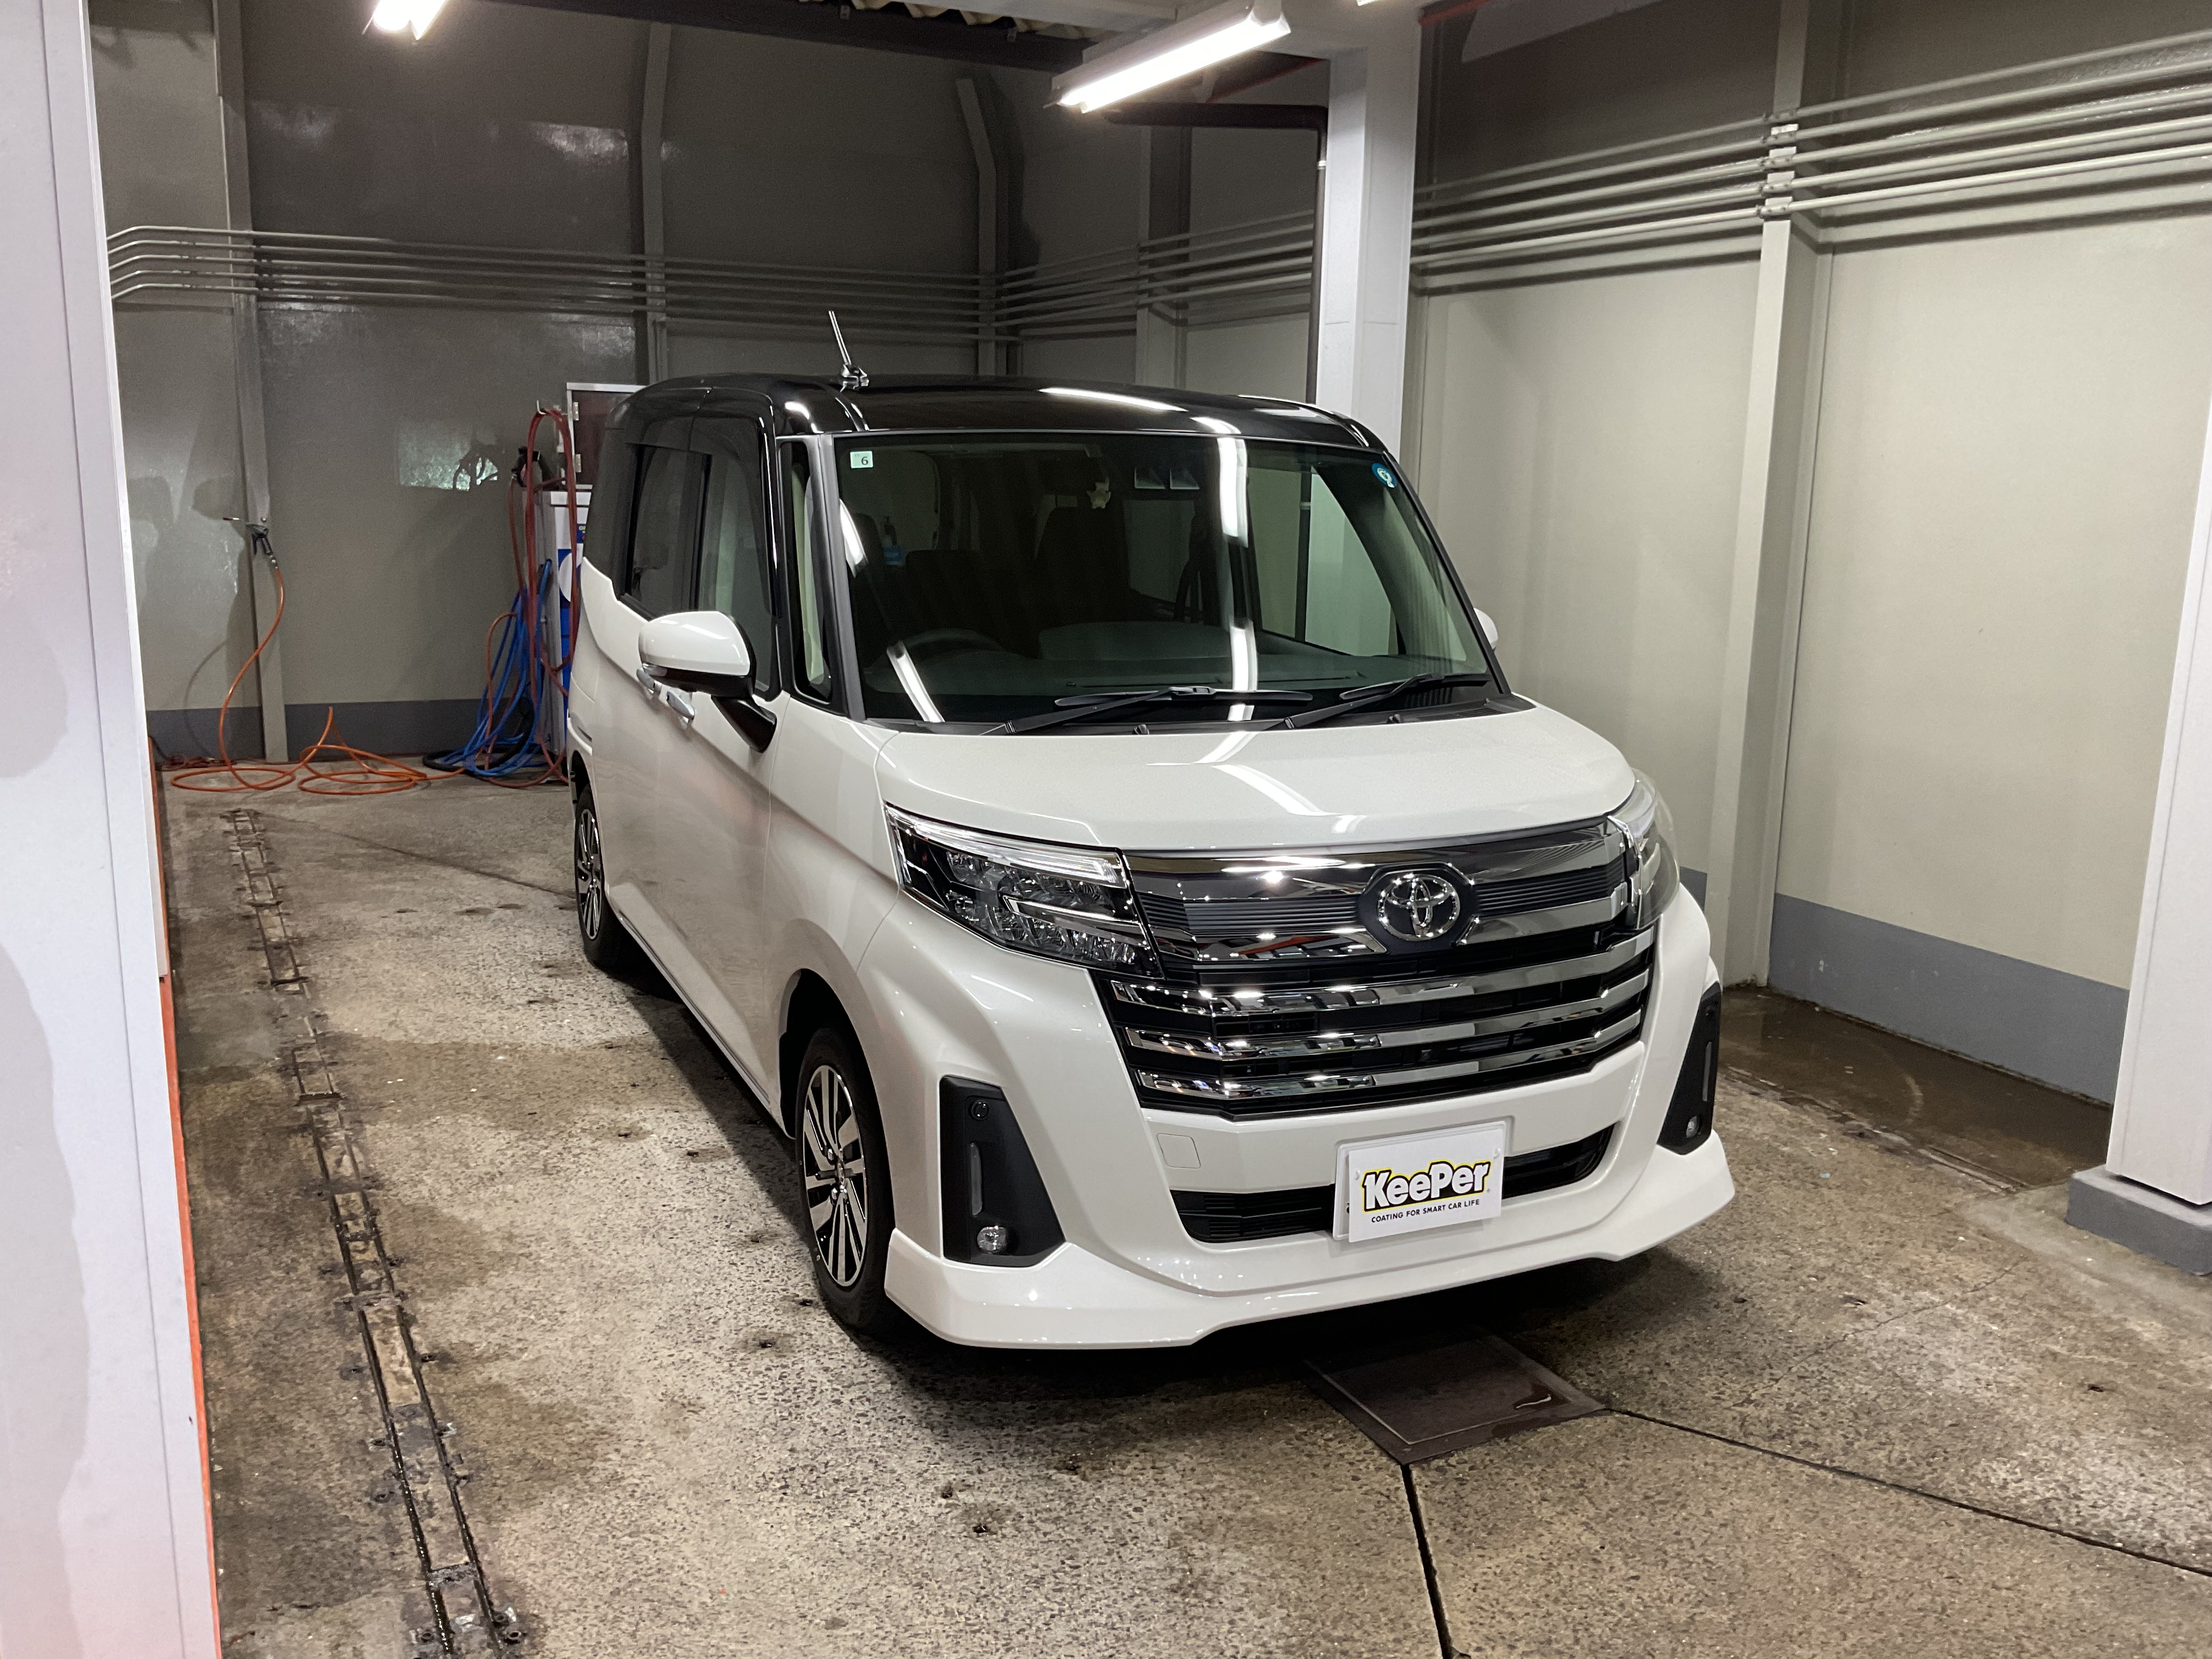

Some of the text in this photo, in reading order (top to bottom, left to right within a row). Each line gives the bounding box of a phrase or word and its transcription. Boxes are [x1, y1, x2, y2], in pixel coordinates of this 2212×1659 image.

[861, 456, 868, 465] 6
[1362, 1161, 1491, 1211] KeePer
[1372, 1212, 1403, 1223] COATING
[1423, 1204, 1446, 1214] SMART
[1448, 1201, 1462, 1210] CAR
[1464, 1199, 1480, 1207] LIFE
